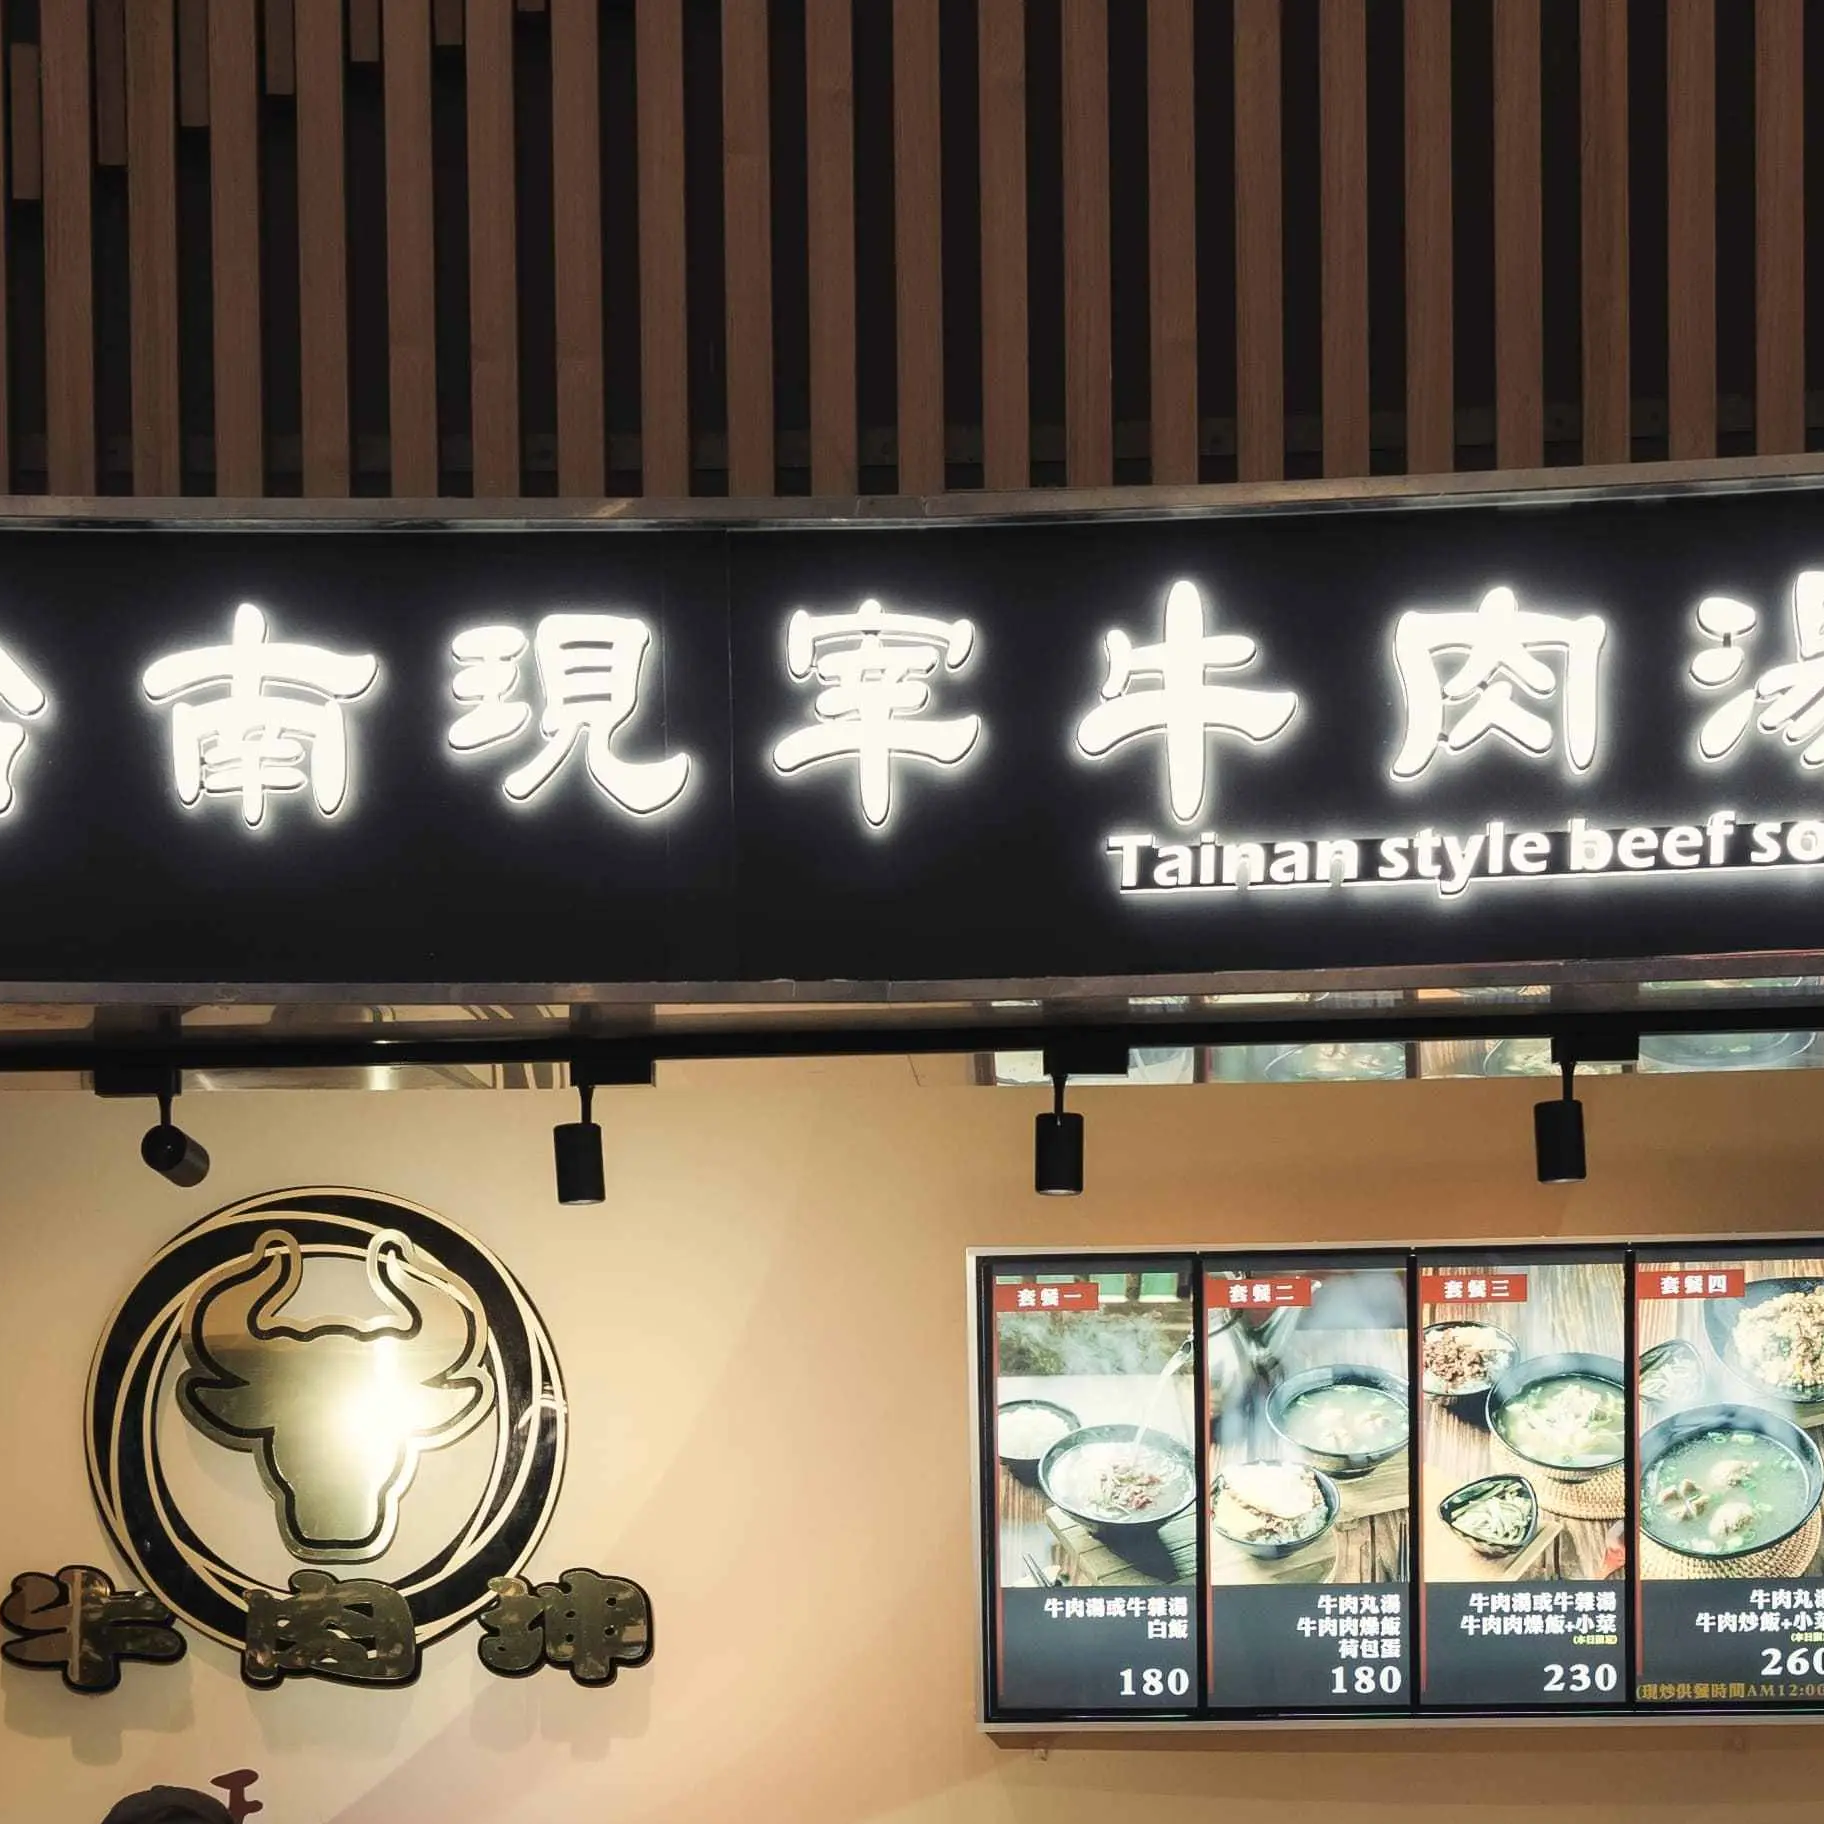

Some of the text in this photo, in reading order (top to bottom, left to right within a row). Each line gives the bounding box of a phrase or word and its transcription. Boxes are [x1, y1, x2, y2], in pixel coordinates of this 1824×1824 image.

[1107, 832, 1359, 890] Tainan
[1377, 822, 1551, 897] style
[1569, 809, 1734, 872] beef
[1228, 1283, 1295, 1304] 套餐二
[1444, 1278, 1511, 1300] 套餐三
[1660, 1274, 1728, 1296] 套餐四
[1016, 1287, 1083, 1309] 套餐一
[1044, 1597, 1189, 1619] 牛肉湯或牛雜湯
[1317, 1593, 1401, 1616] 牛肉丸湯
[1469, 1591, 1617, 1613] 牛肉湯或牛雜湯
[1146, 1619, 1189, 1640] 白飯
[1337, 1637, 1402, 1660] 荷包蛋
[1119, 1667, 1190, 1696] 180
[1330, 1665, 1402, 1694] 180
[1543, 1662, 1618, 1692] 230
